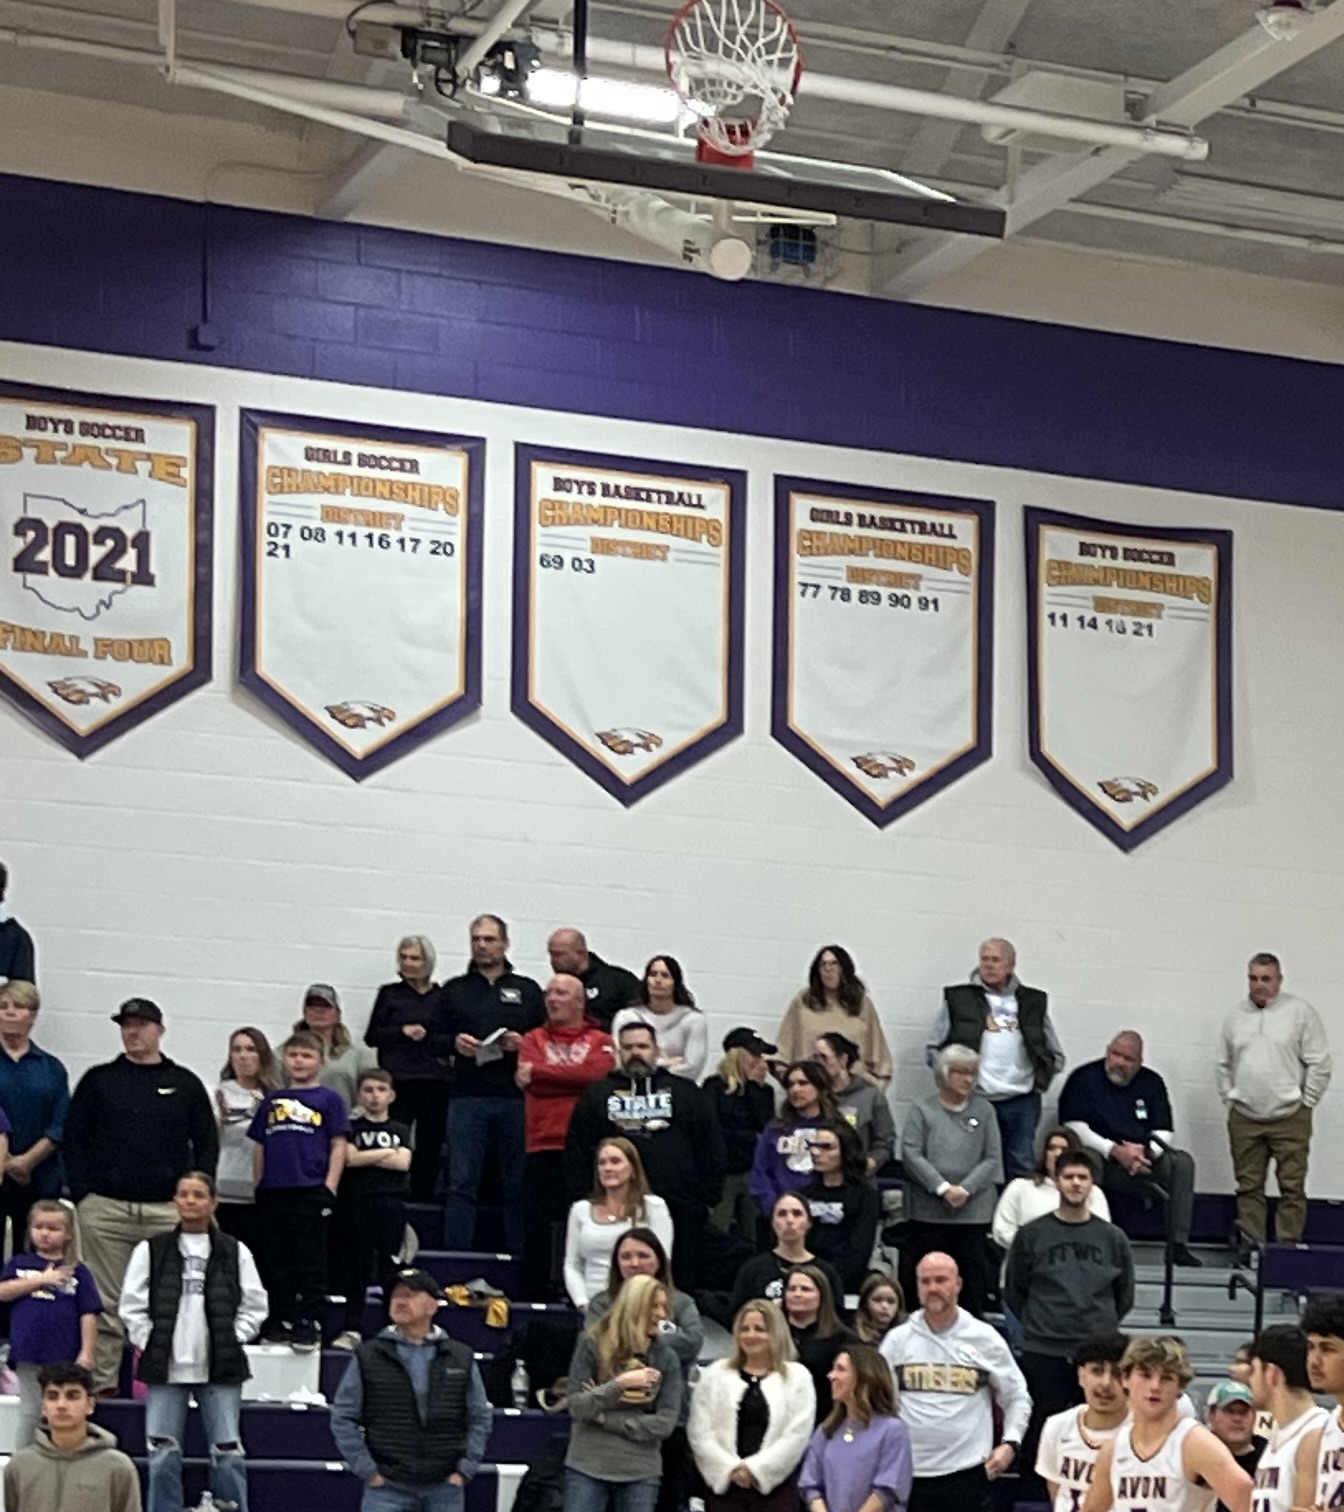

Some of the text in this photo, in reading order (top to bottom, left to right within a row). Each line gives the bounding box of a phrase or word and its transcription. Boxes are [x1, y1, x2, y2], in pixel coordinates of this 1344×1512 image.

[79, 421, 146, 443] SOCCER
[0, 435, 187, 488] STATE
[304, 446, 420, 475] GIRLS SOCCER
[266, 465, 460, 517] CHAMPIONSHIPS
[553, 477, 706, 510] BOYS BASKETBALL
[320, 504, 406, 531] DISTRICT
[539, 498, 723, 548] CHAMPIONSHIPS
[810, 507, 957, 540] GIRLS BASKETBALL
[12, 516, 156, 587] 2021
[266, 541, 291, 559] 21
[267, 522, 292, 539] 07
[334, 530, 358, 547] 11
[364, 533, 391, 550] 16
[396, 537, 421, 553] 17
[429, 540, 455, 557] 20
[590, 536, 670, 562] DISTRICT
[797, 528, 972, 577] CHAMPIONSHIPS
[539, 553, 596, 574] 69 03
[798, 582, 821, 598] 77
[828, 585, 852, 602] 78
[888, 592, 912, 609] 90
[918, 596, 940, 612] 91
[1046, 559, 1213, 605] CHAMPIONSHIPS
[1047, 612, 1068, 628] 11
[1076, 615, 1098, 631] 14
[1132, 621, 1154, 638] 21
[0, 620, 173, 666] FINAL FOUR
[607, 1094, 673, 1113] STATE
[1118, 1476, 1167, 1499] AVON
